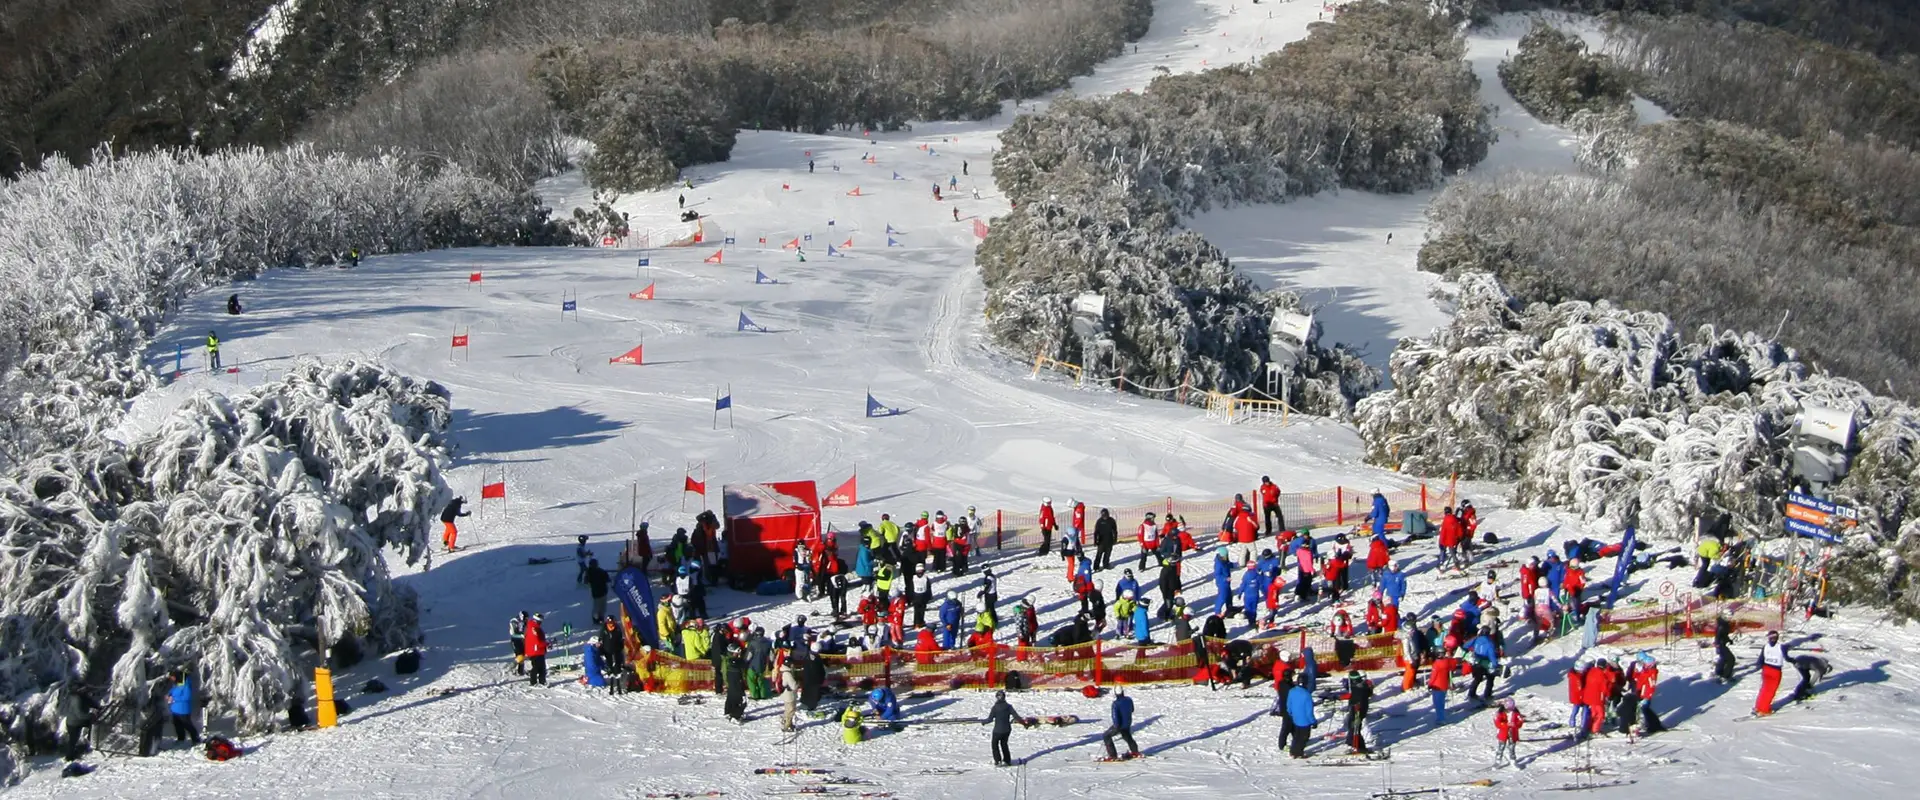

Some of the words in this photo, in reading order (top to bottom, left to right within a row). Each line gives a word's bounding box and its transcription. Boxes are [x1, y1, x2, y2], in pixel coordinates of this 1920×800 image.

[1797, 497, 1817, 507] Buller
[1818, 503, 1835, 512] Spur
[1789, 521, 1816, 533] Wombat
